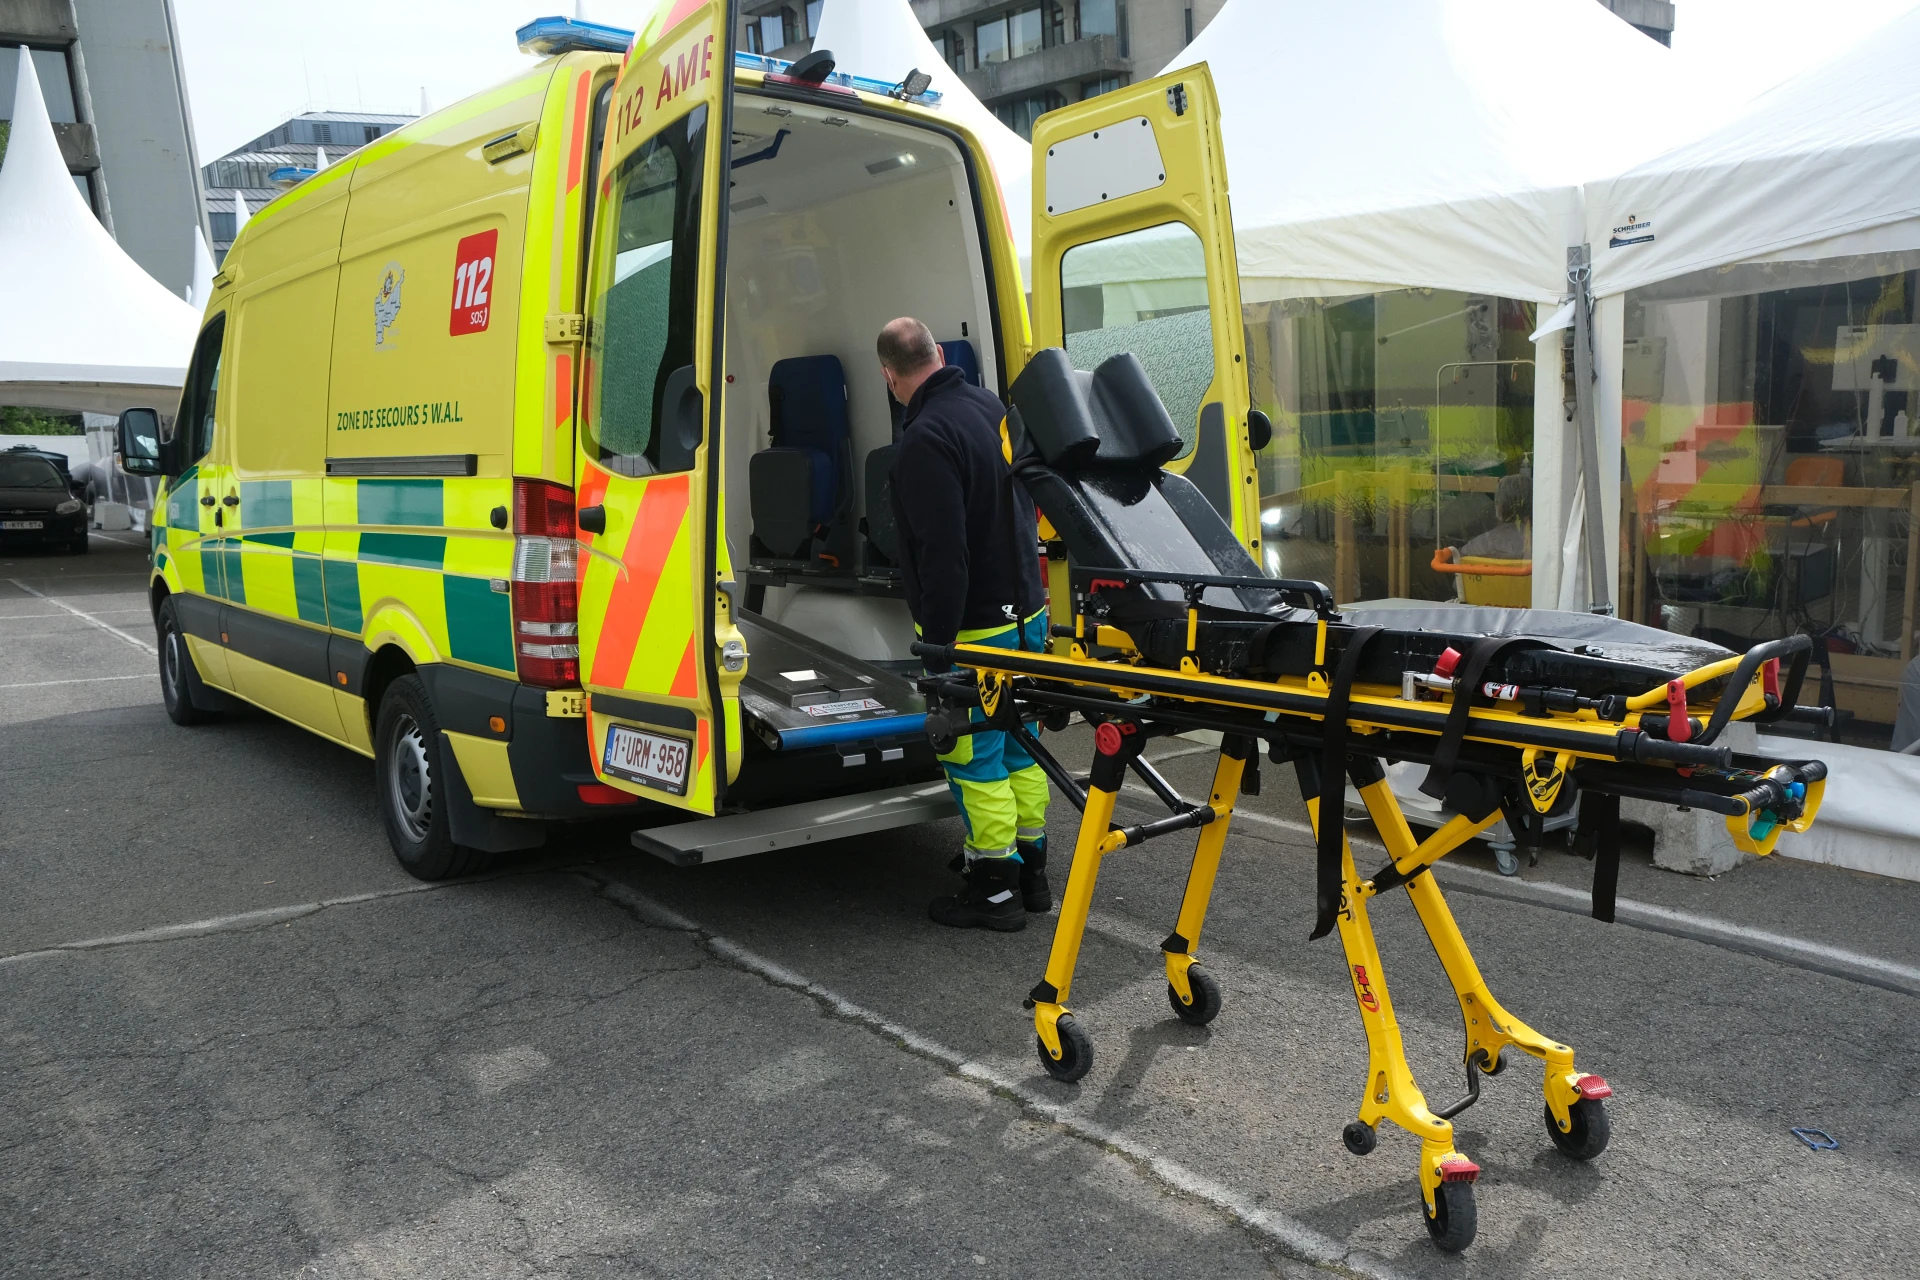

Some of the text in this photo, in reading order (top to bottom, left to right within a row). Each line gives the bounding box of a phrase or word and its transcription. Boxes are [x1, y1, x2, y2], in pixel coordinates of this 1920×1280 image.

[617, 86, 644, 144] 112
[1613, 221, 1650, 234] SCHREIBER
[454, 256, 492, 309] 112
[470, 310, 484, 324] SOS
[337, 401, 463, 430] ZONE DE SECOURS 5 W.A.L.
[614, 734, 684, 777] 1-URM-958
